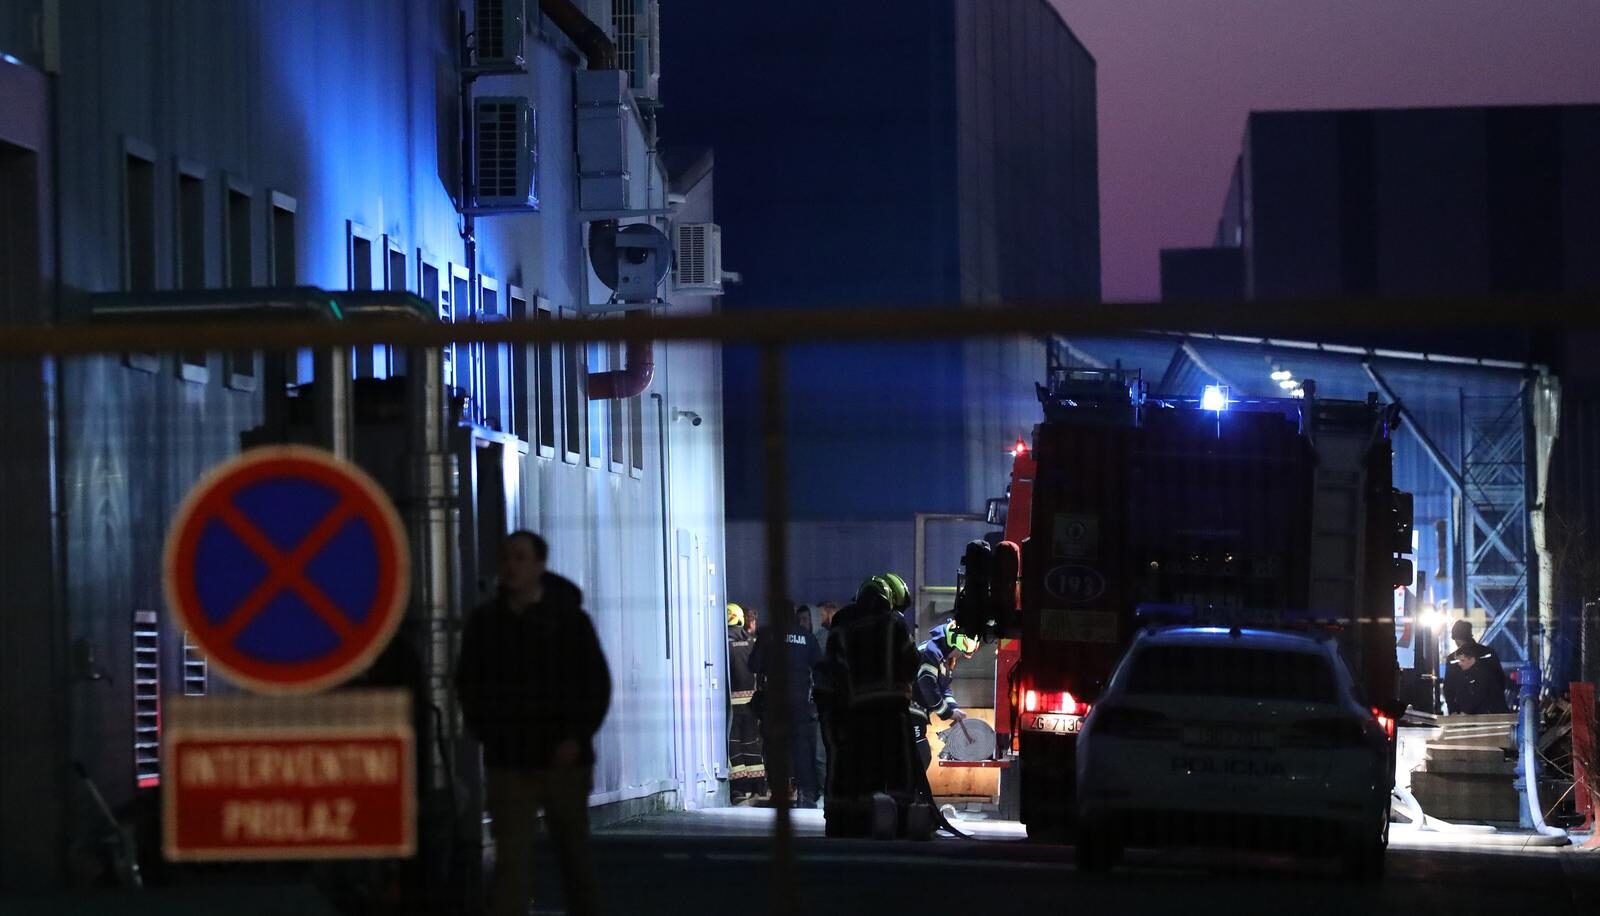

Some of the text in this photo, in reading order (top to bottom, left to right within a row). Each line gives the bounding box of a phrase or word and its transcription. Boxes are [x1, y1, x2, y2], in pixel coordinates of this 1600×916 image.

[1057, 574, 1094, 597] 193
[1031, 716, 1045, 730] ZG
[179, 744, 398, 789] INTERVENTNI
[1170, 757, 1287, 777] POLICIJA
[221, 797, 358, 842] PROLAZ
